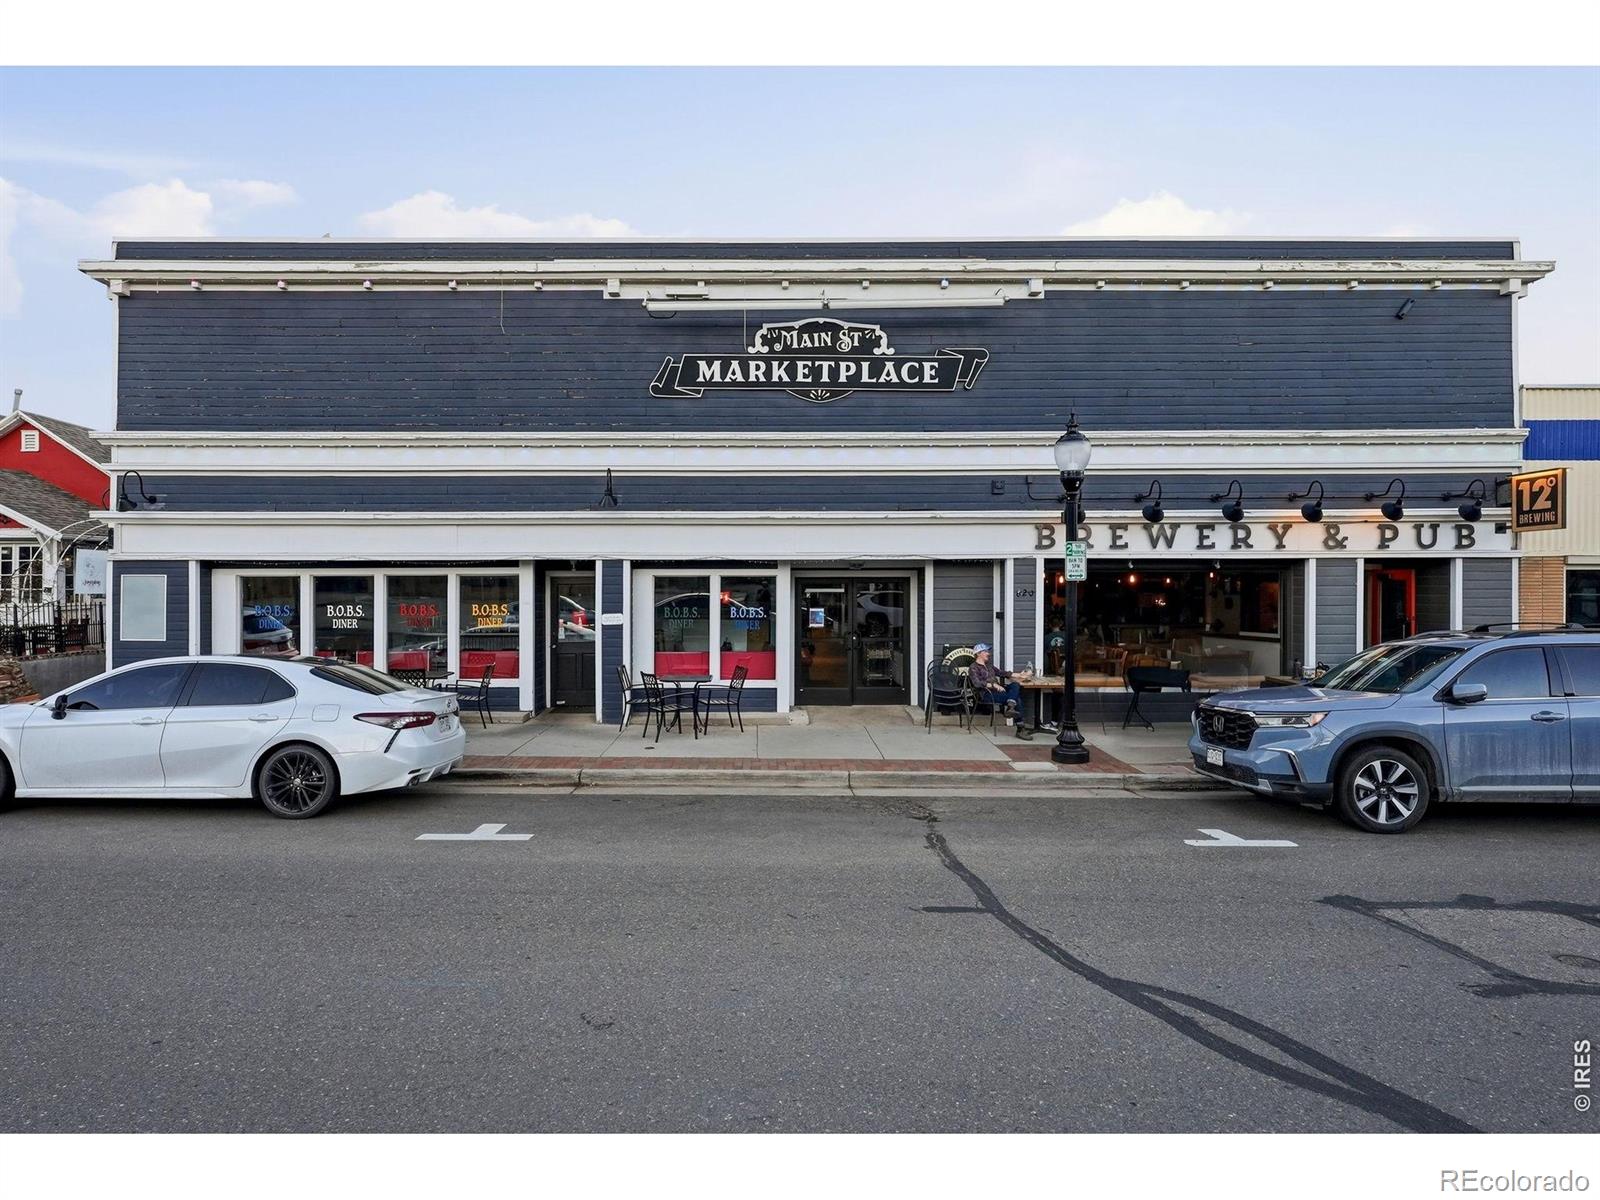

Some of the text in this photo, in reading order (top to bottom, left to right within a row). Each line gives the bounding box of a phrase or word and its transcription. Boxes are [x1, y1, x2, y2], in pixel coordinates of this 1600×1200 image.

[696, 360, 939, 383] MARKETPLACE
[1519, 511, 1556, 524] BREWING
[1035, 523, 1476, 550] BREWERY & PUB
[255, 605, 293, 616] B.O.B.S.
[327, 605, 365, 616] B.O.B.S.
[400, 603, 439, 616] B.O.B.S.
[472, 604, 510, 616] B.O.B.S.
[664, 607, 701, 618] B.O.B.S.
[730, 607, 767, 618] B.O.B.S.
[332, 619, 358, 628] DINER
[477, 618, 503, 627] DINER
[669, 620, 694, 629] DINER
